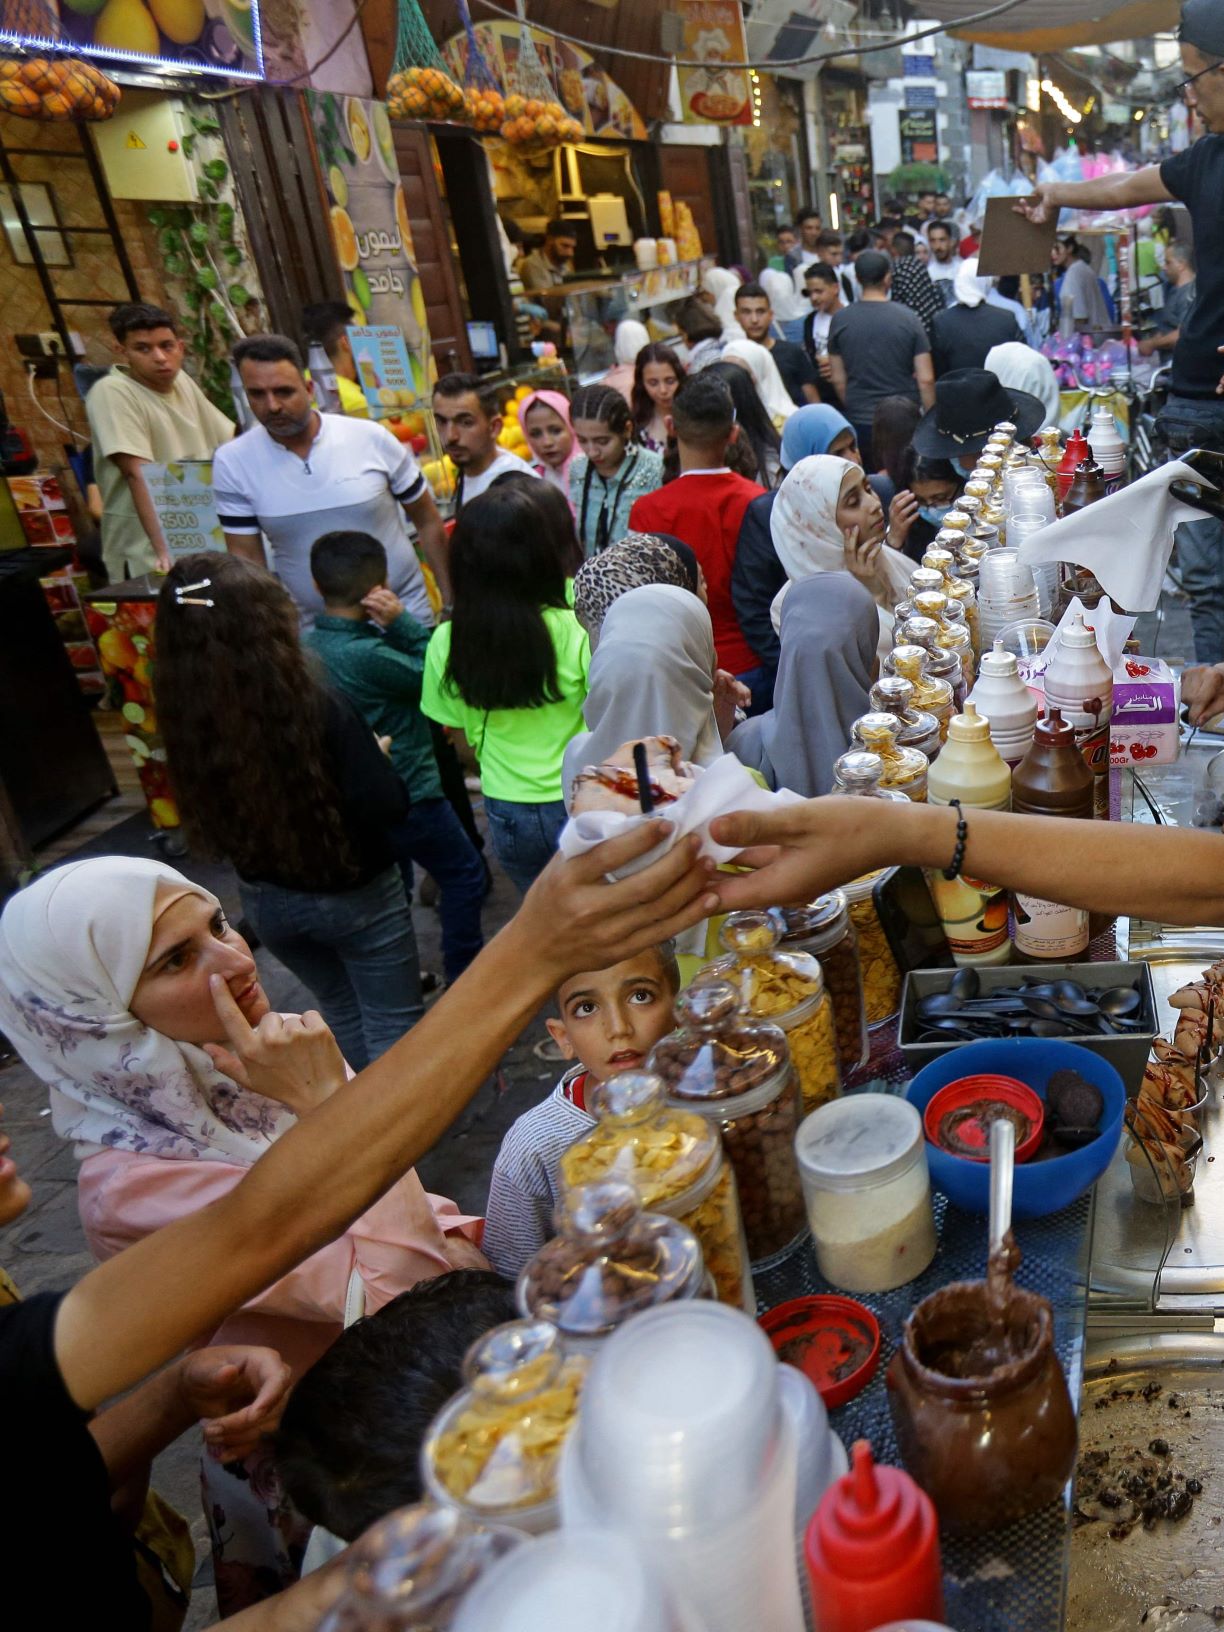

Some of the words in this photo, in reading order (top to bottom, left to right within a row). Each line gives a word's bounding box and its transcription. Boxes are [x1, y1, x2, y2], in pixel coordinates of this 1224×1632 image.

[356, 224, 402, 259] ليمون
[367, 267, 405, 298] جامد
[166, 532, 207, 549] 2500
[1132, 693, 1153, 702] مناديل
[1110, 756, 1130, 765] 00Gr
